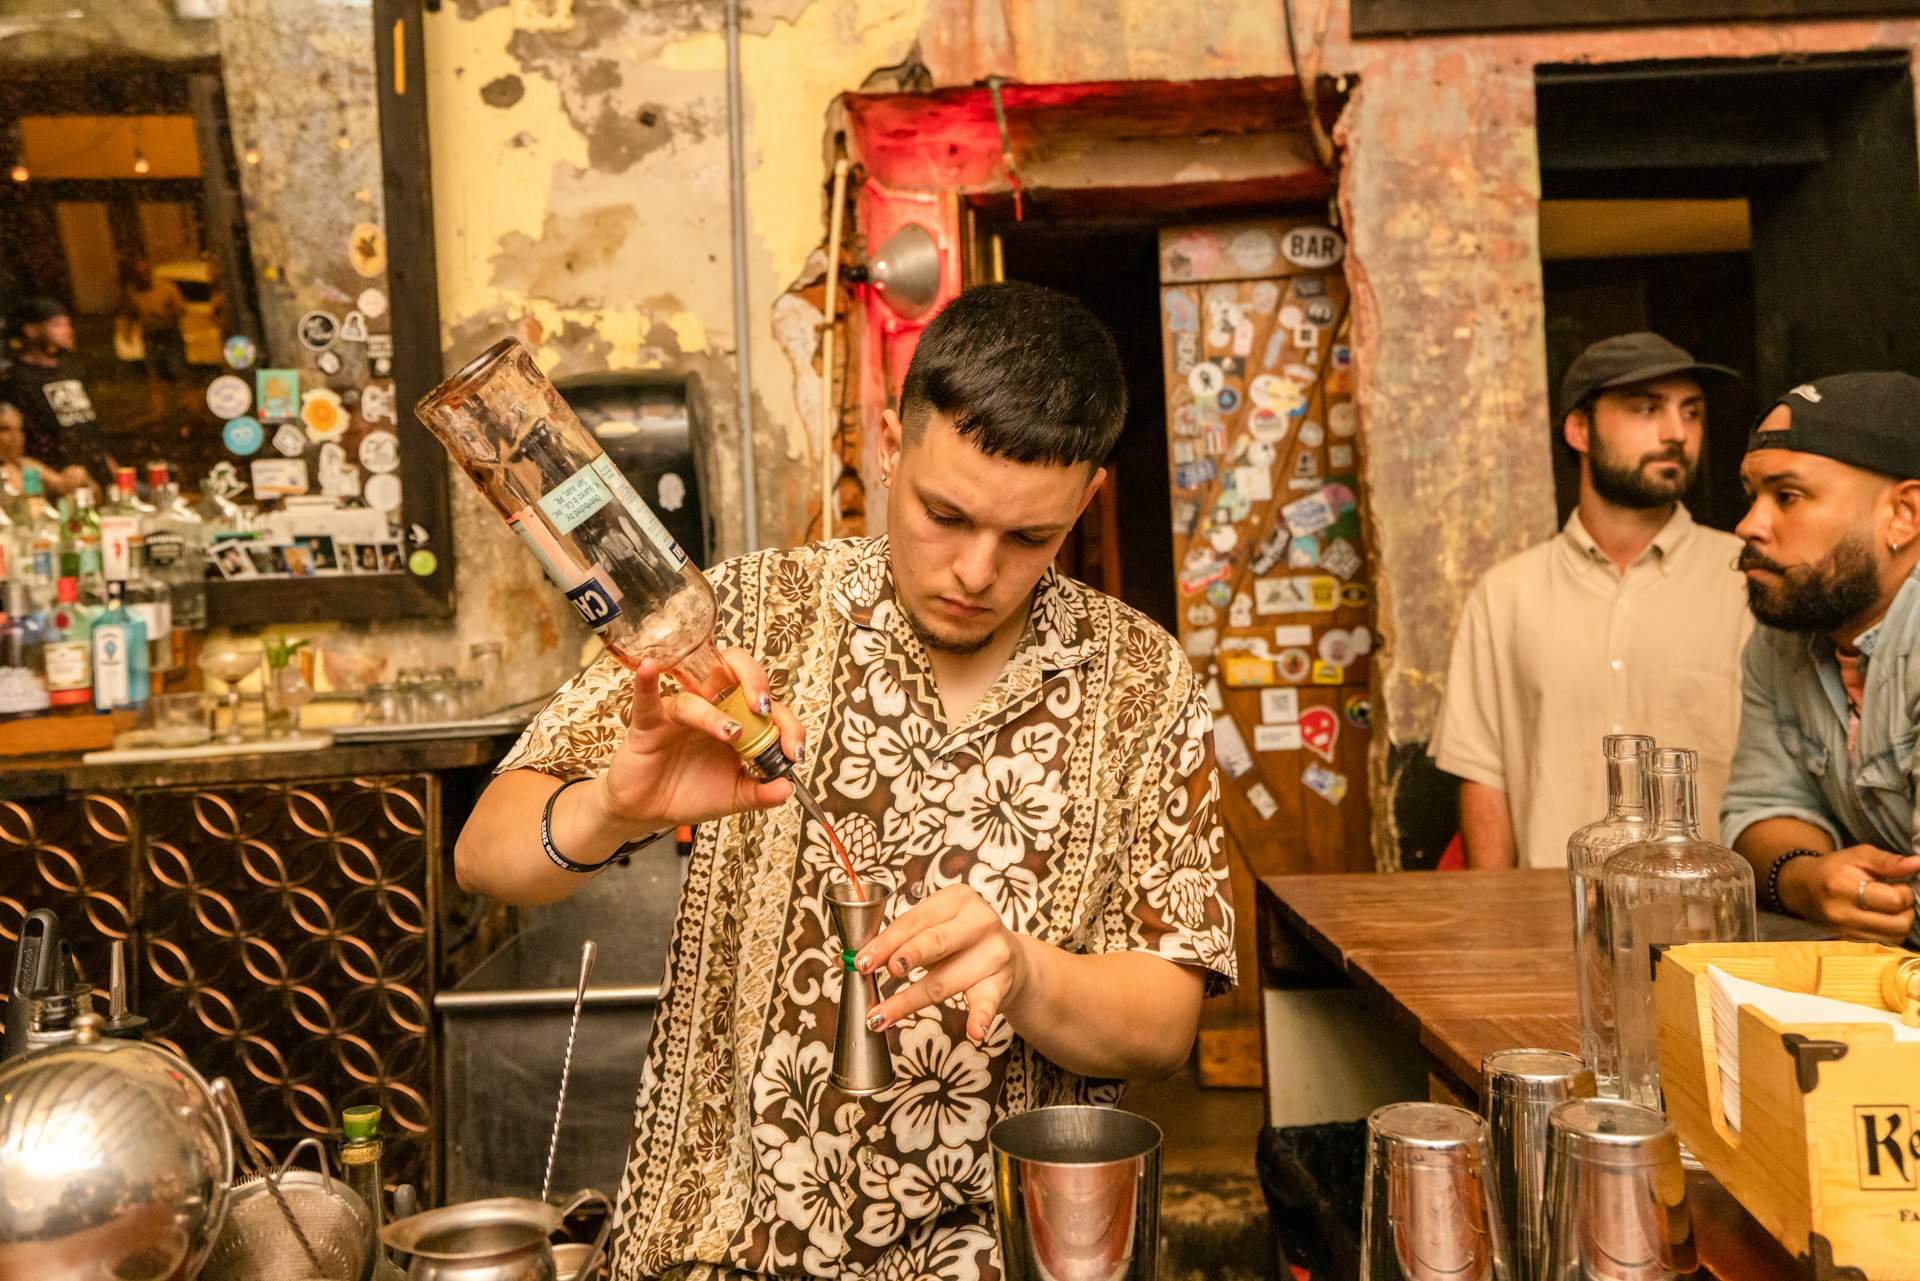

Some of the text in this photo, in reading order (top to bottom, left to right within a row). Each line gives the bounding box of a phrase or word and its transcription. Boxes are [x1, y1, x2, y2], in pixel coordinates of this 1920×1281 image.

[1291, 235, 1336, 258] BAR
[573, 494, 602, 517] Distributed
[571, 590, 609, 622] CA
[1861, 1113, 1920, 1182] Ke
